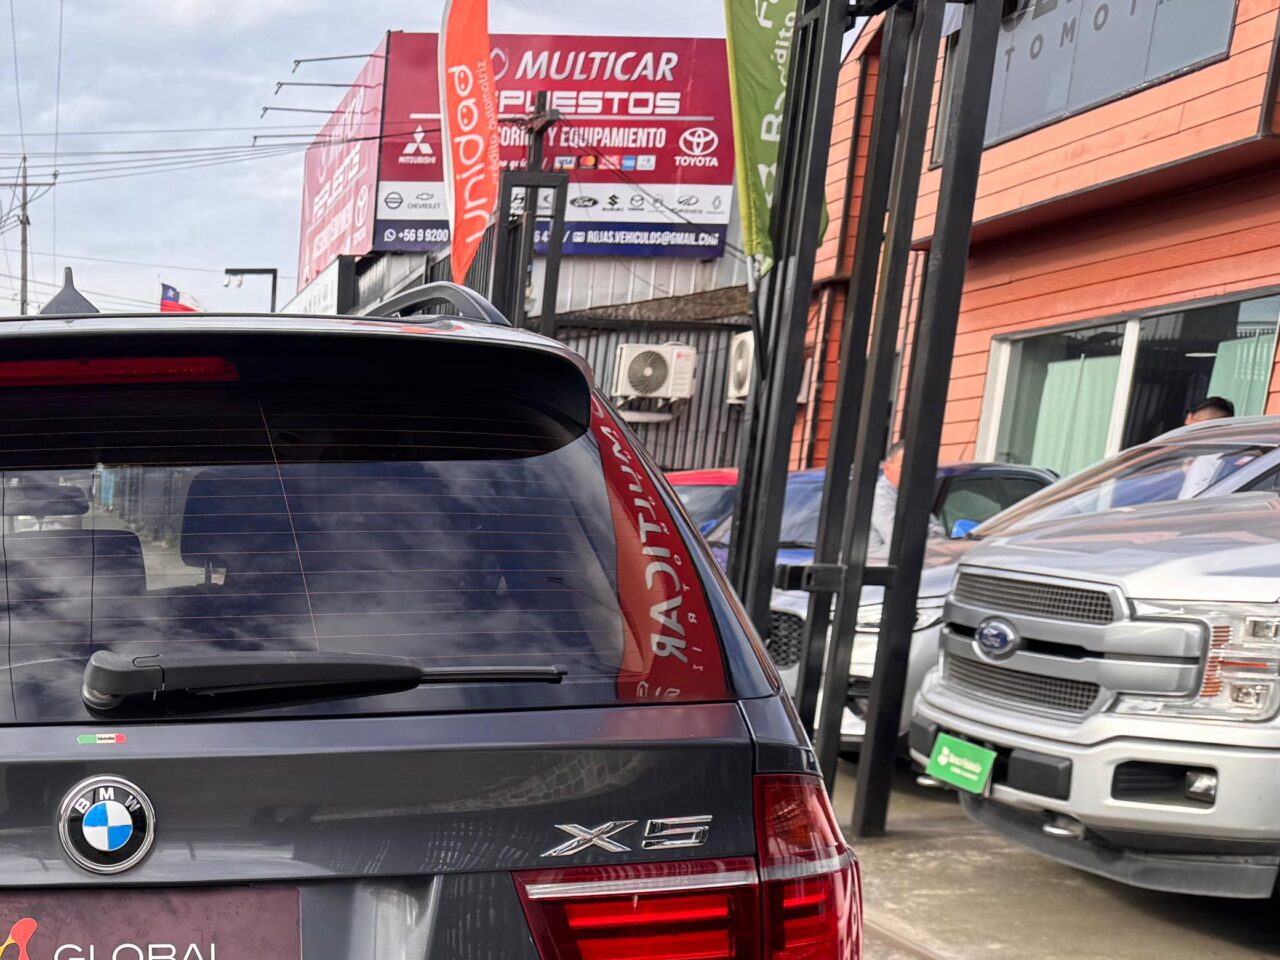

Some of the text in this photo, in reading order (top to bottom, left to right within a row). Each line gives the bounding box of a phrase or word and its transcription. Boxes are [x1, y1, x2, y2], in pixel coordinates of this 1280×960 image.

[515, 51, 679, 82] MULTICAR
[476, 59, 498, 131] automotriz
[495, 90, 681, 114] PUESTOS
[547, 128, 557, 146] Y
[560, 127, 666, 148] EQUIPAMIENTO
[448, 65, 488, 243] unidad
[674, 156, 719, 167] TOYOTA
[398, 230, 415, 241] +56
[417, 230, 423, 241] 9
[425, 230, 449, 241] 9200
[74, 787, 141, 814] BMW
[540, 815, 713, 858] X5
